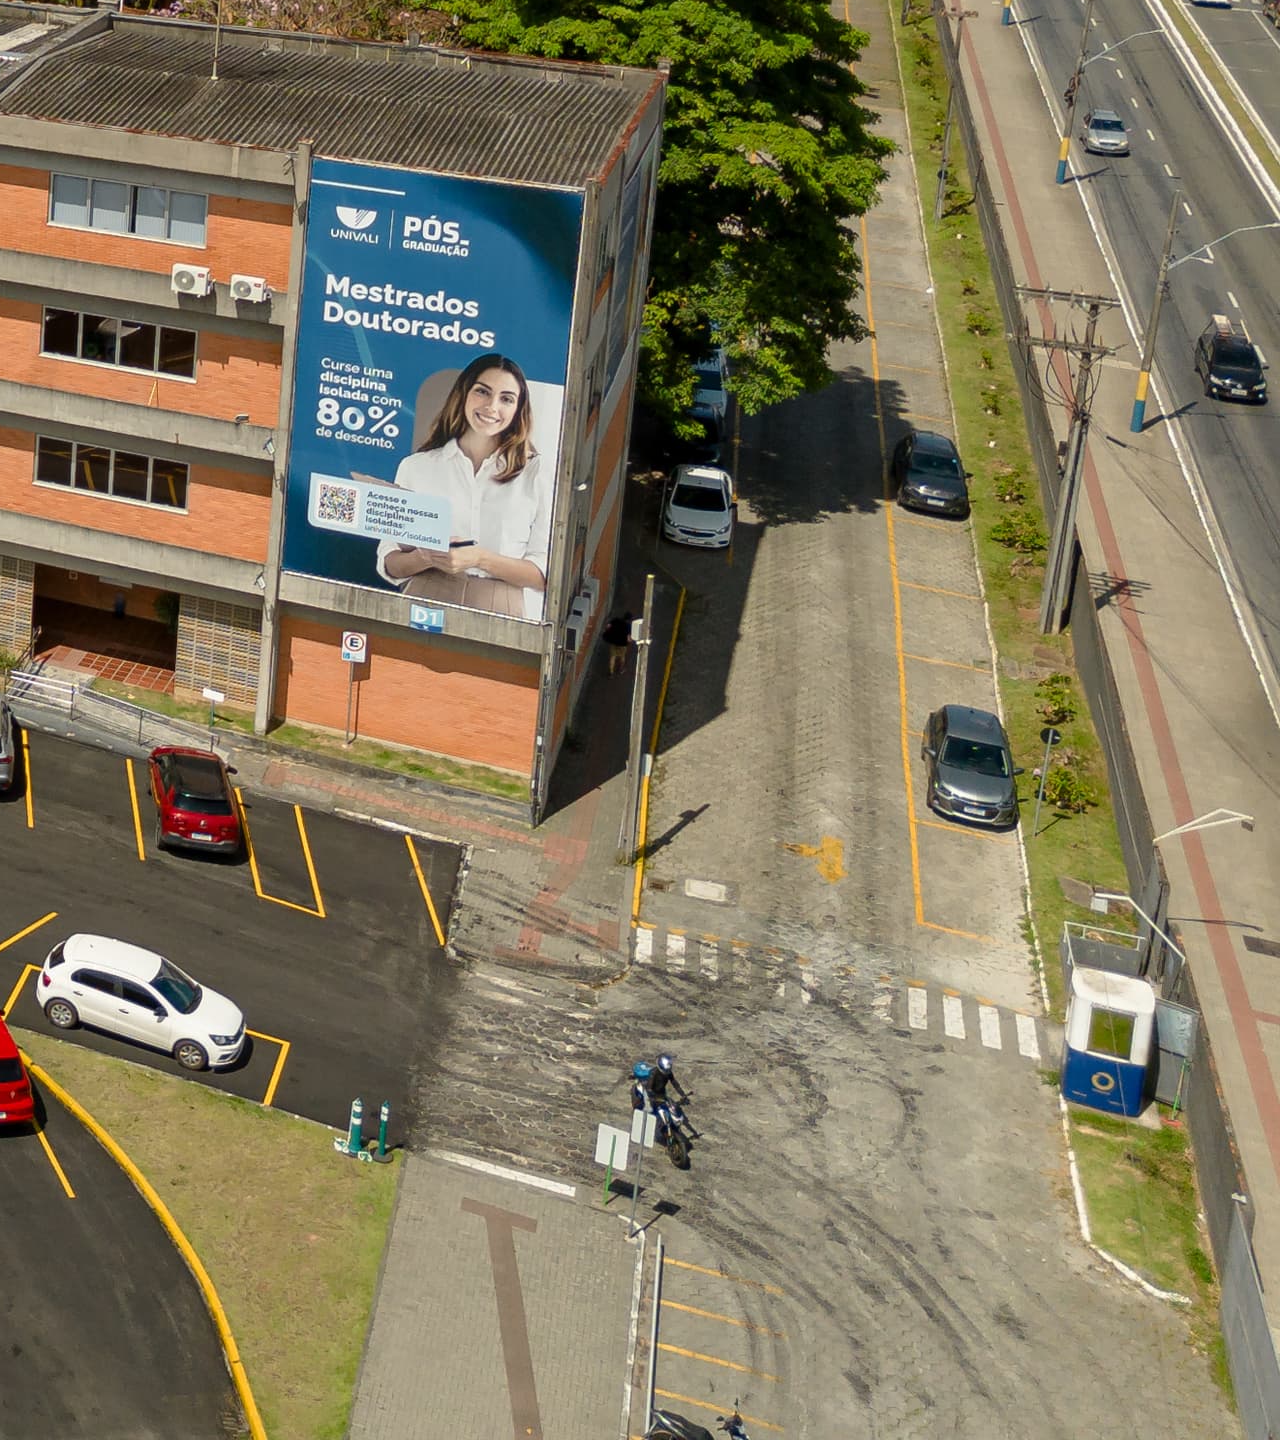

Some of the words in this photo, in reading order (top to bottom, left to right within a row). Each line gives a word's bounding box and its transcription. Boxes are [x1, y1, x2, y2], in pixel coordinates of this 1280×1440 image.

[330, 228, 379, 244] UNIVALI
[402, 239, 470, 257] GRADUAÇÃO
[325, 273, 479, 318] Mestrados
[323, 300, 496, 348] Doutorados
[321, 357, 360, 374] Curse
[363, 365, 393, 380] uma
[320, 371, 387, 392] disciplina
[319, 383, 369, 402] isolada
[372, 395, 402, 408] com
[316, 397, 400, 438] 80%
[315, 426, 333, 438] de
[334, 429, 395, 449] desconto.
[366, 507, 415, 523] disciplinas
[407, 507, 439, 519] nossas
[414, 606, 438, 626] D1
